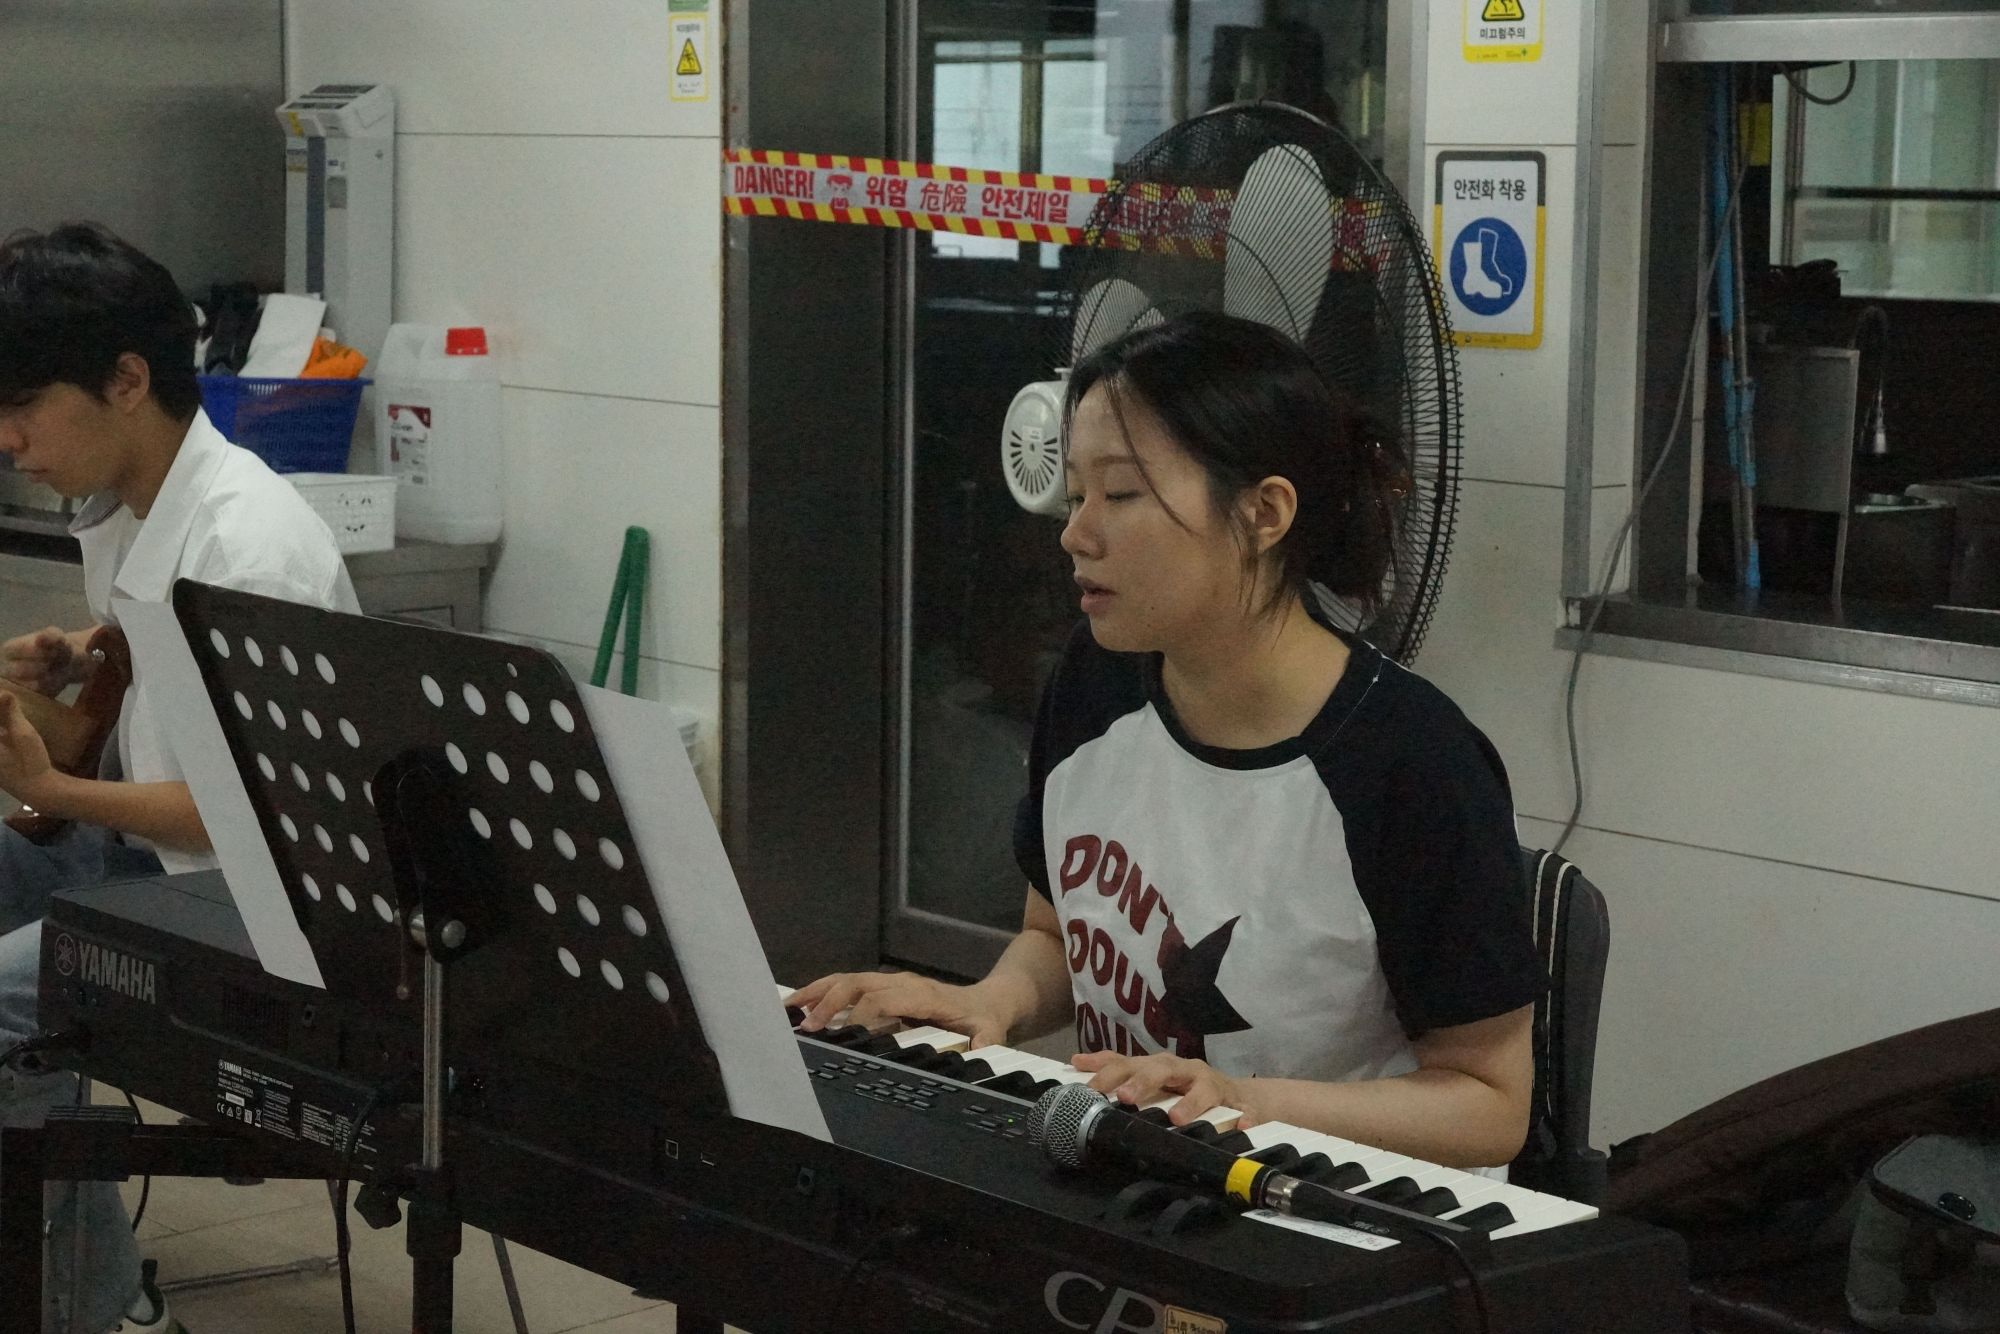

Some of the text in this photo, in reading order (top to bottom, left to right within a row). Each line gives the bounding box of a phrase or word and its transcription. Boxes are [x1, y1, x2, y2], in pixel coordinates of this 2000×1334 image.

[734, 165, 814, 200] DANGER!
[866, 176, 908, 208] 위험
[981, 186, 1070, 224] 안전제일
[1454, 178, 1527, 201] 안전화 착용
[79, 940, 156, 1005] YAMAHA
